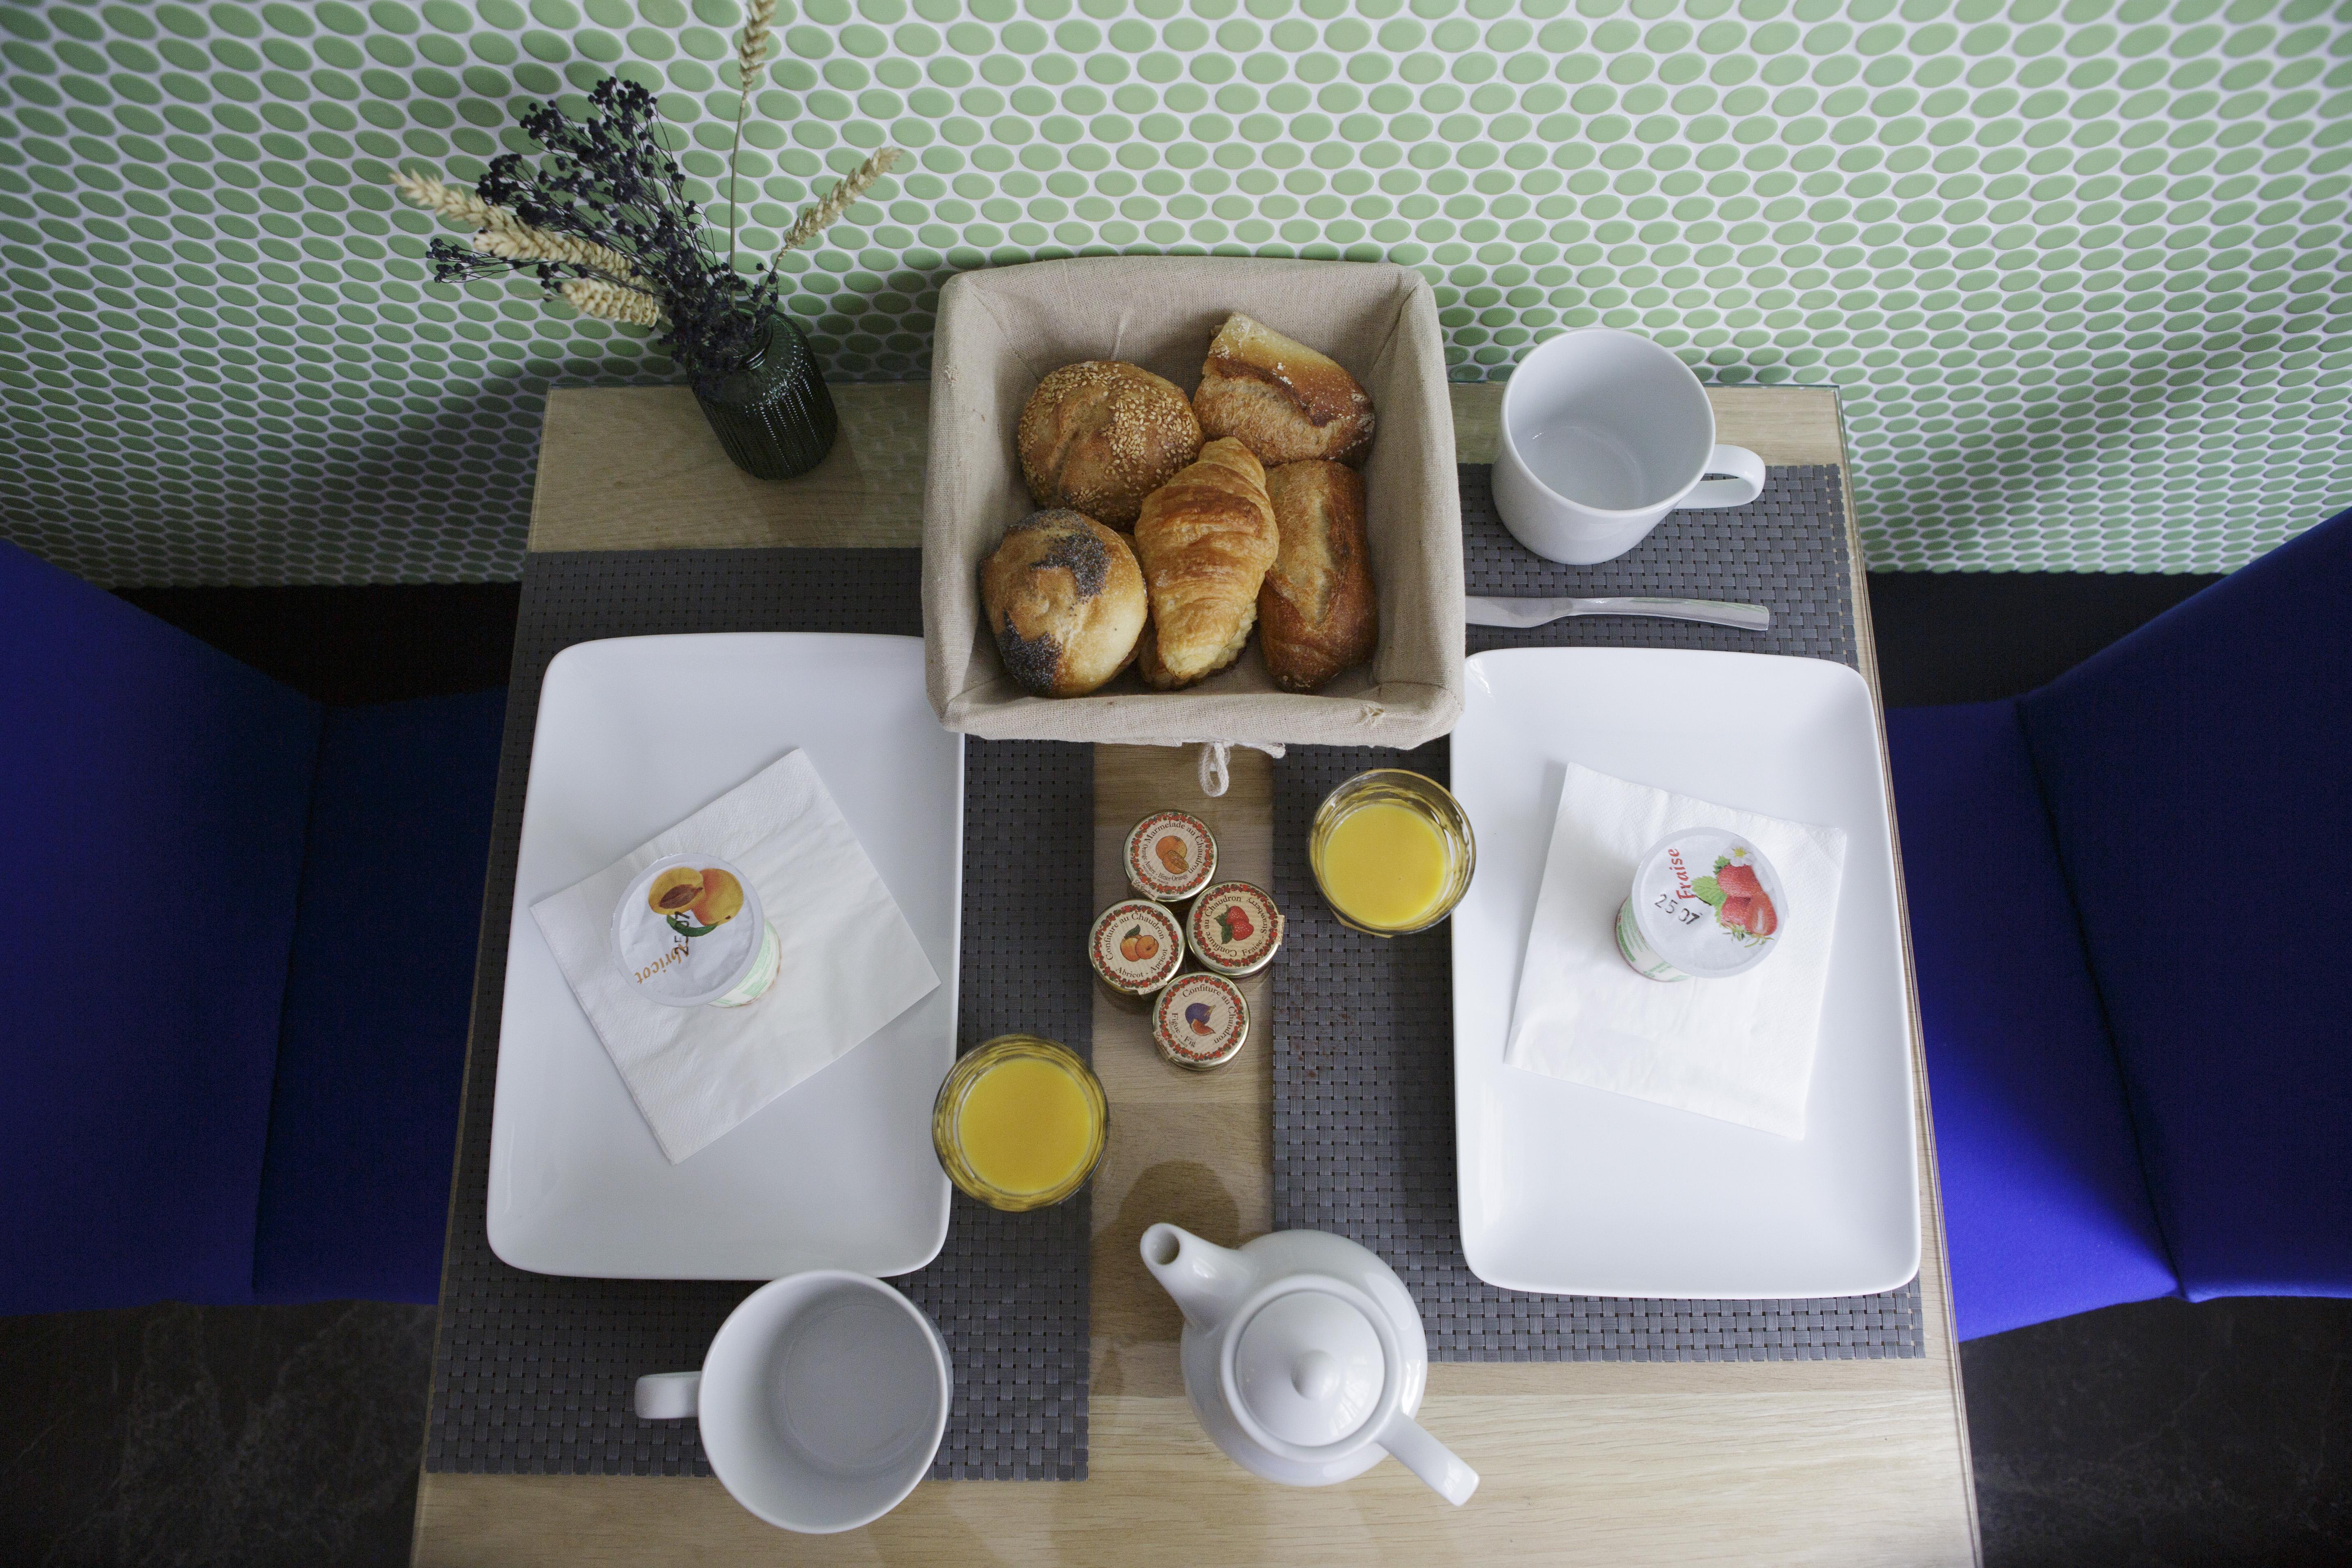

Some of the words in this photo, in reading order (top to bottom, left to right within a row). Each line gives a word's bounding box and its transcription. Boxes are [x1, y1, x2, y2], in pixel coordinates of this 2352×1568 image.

[1144, 821, 1185, 844] Marmelade
[1186, 828, 1196, 836] au
[1188, 836, 1205, 874] Chaudron
[1158, 873, 1171, 881] Bitter
[1668, 849, 1696, 900] Fraise
[1205, 895, 1241, 917] Chaudron
[1655, 893, 1678, 913] 25
[1204, 920, 1209, 929] au
[1246, 898, 1267, 934] Strawberry
[1103, 922, 1119, 960] Confiture
[1131, 913, 1164, 940] Chaudron
[1205, 931, 1237, 957] Confiture
[1241, 940, 1263, 956] Fraise
[634, 943, 690, 984] Abricot
[1116, 967, 1144, 978] Abricot
[1150, 948, 1168, 973] Apricot
[1183, 984, 1221, 997] Confiture
[1221, 996, 1230, 1005] au
[1172, 1013, 1180, 1033] Figue
[1184, 1036, 1196, 1047] Fig
[1214, 1006, 1236, 1044] Chaudron
